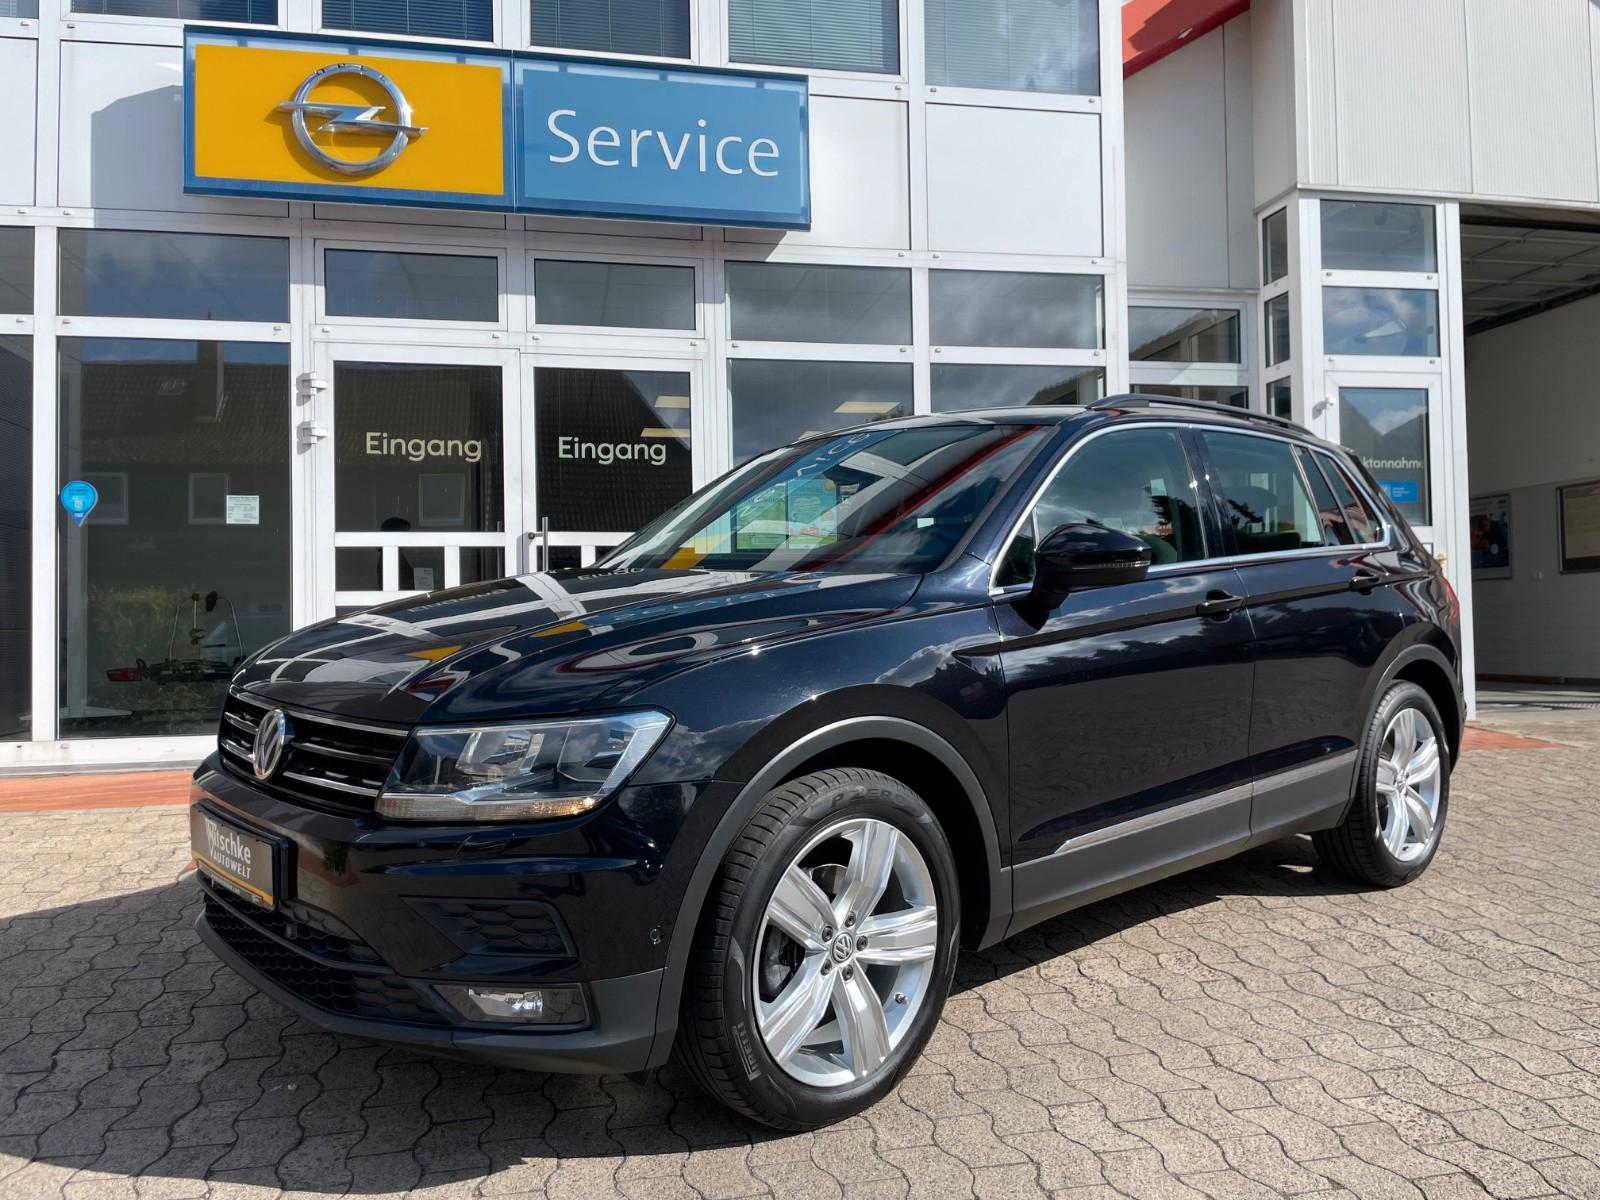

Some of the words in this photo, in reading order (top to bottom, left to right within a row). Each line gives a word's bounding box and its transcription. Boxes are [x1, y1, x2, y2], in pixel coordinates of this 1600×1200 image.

[547, 109, 780, 177] Service
[365, 431, 482, 463] Eingang
[557, 436, 667, 465] Eingang
[213, 849, 251, 879] AUTOWELT
